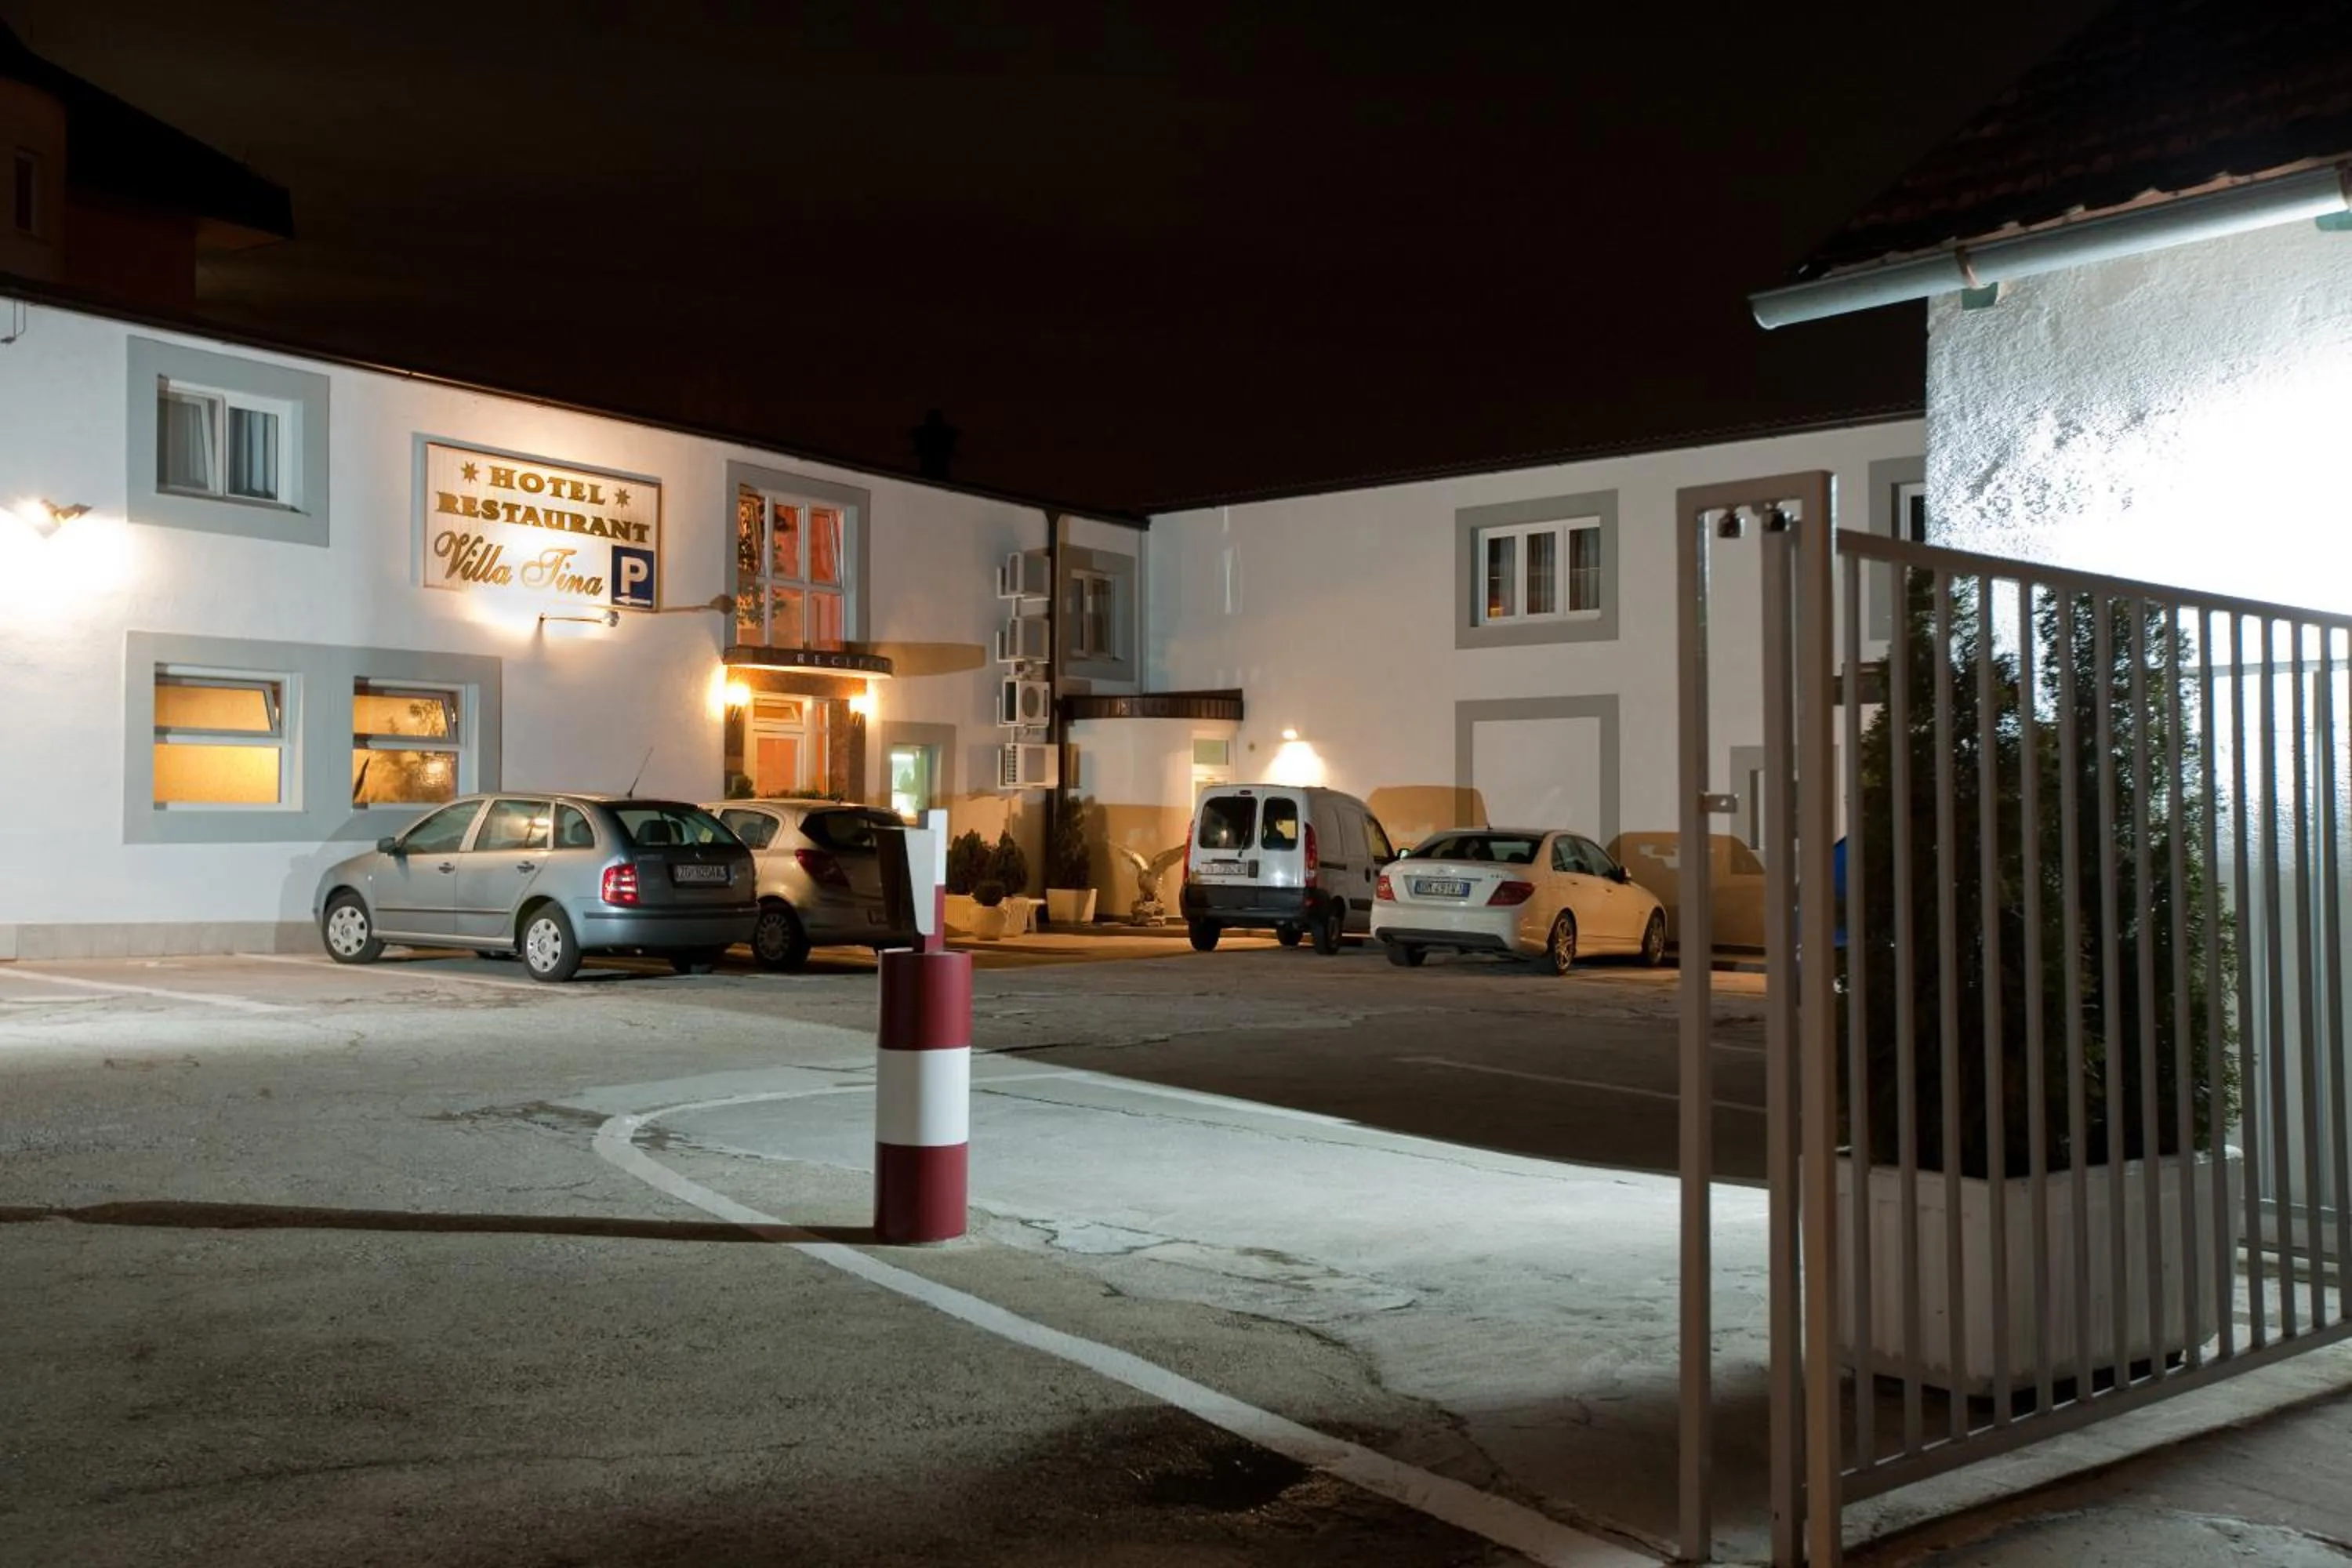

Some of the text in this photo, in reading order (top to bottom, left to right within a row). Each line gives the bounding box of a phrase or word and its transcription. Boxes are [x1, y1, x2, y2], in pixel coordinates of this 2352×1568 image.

[489, 465, 606, 505] HOTEL
[436, 492, 651, 543] RESTAURANT
[434, 530, 603, 597] Villa Tina
[620, 557, 648, 593] P
